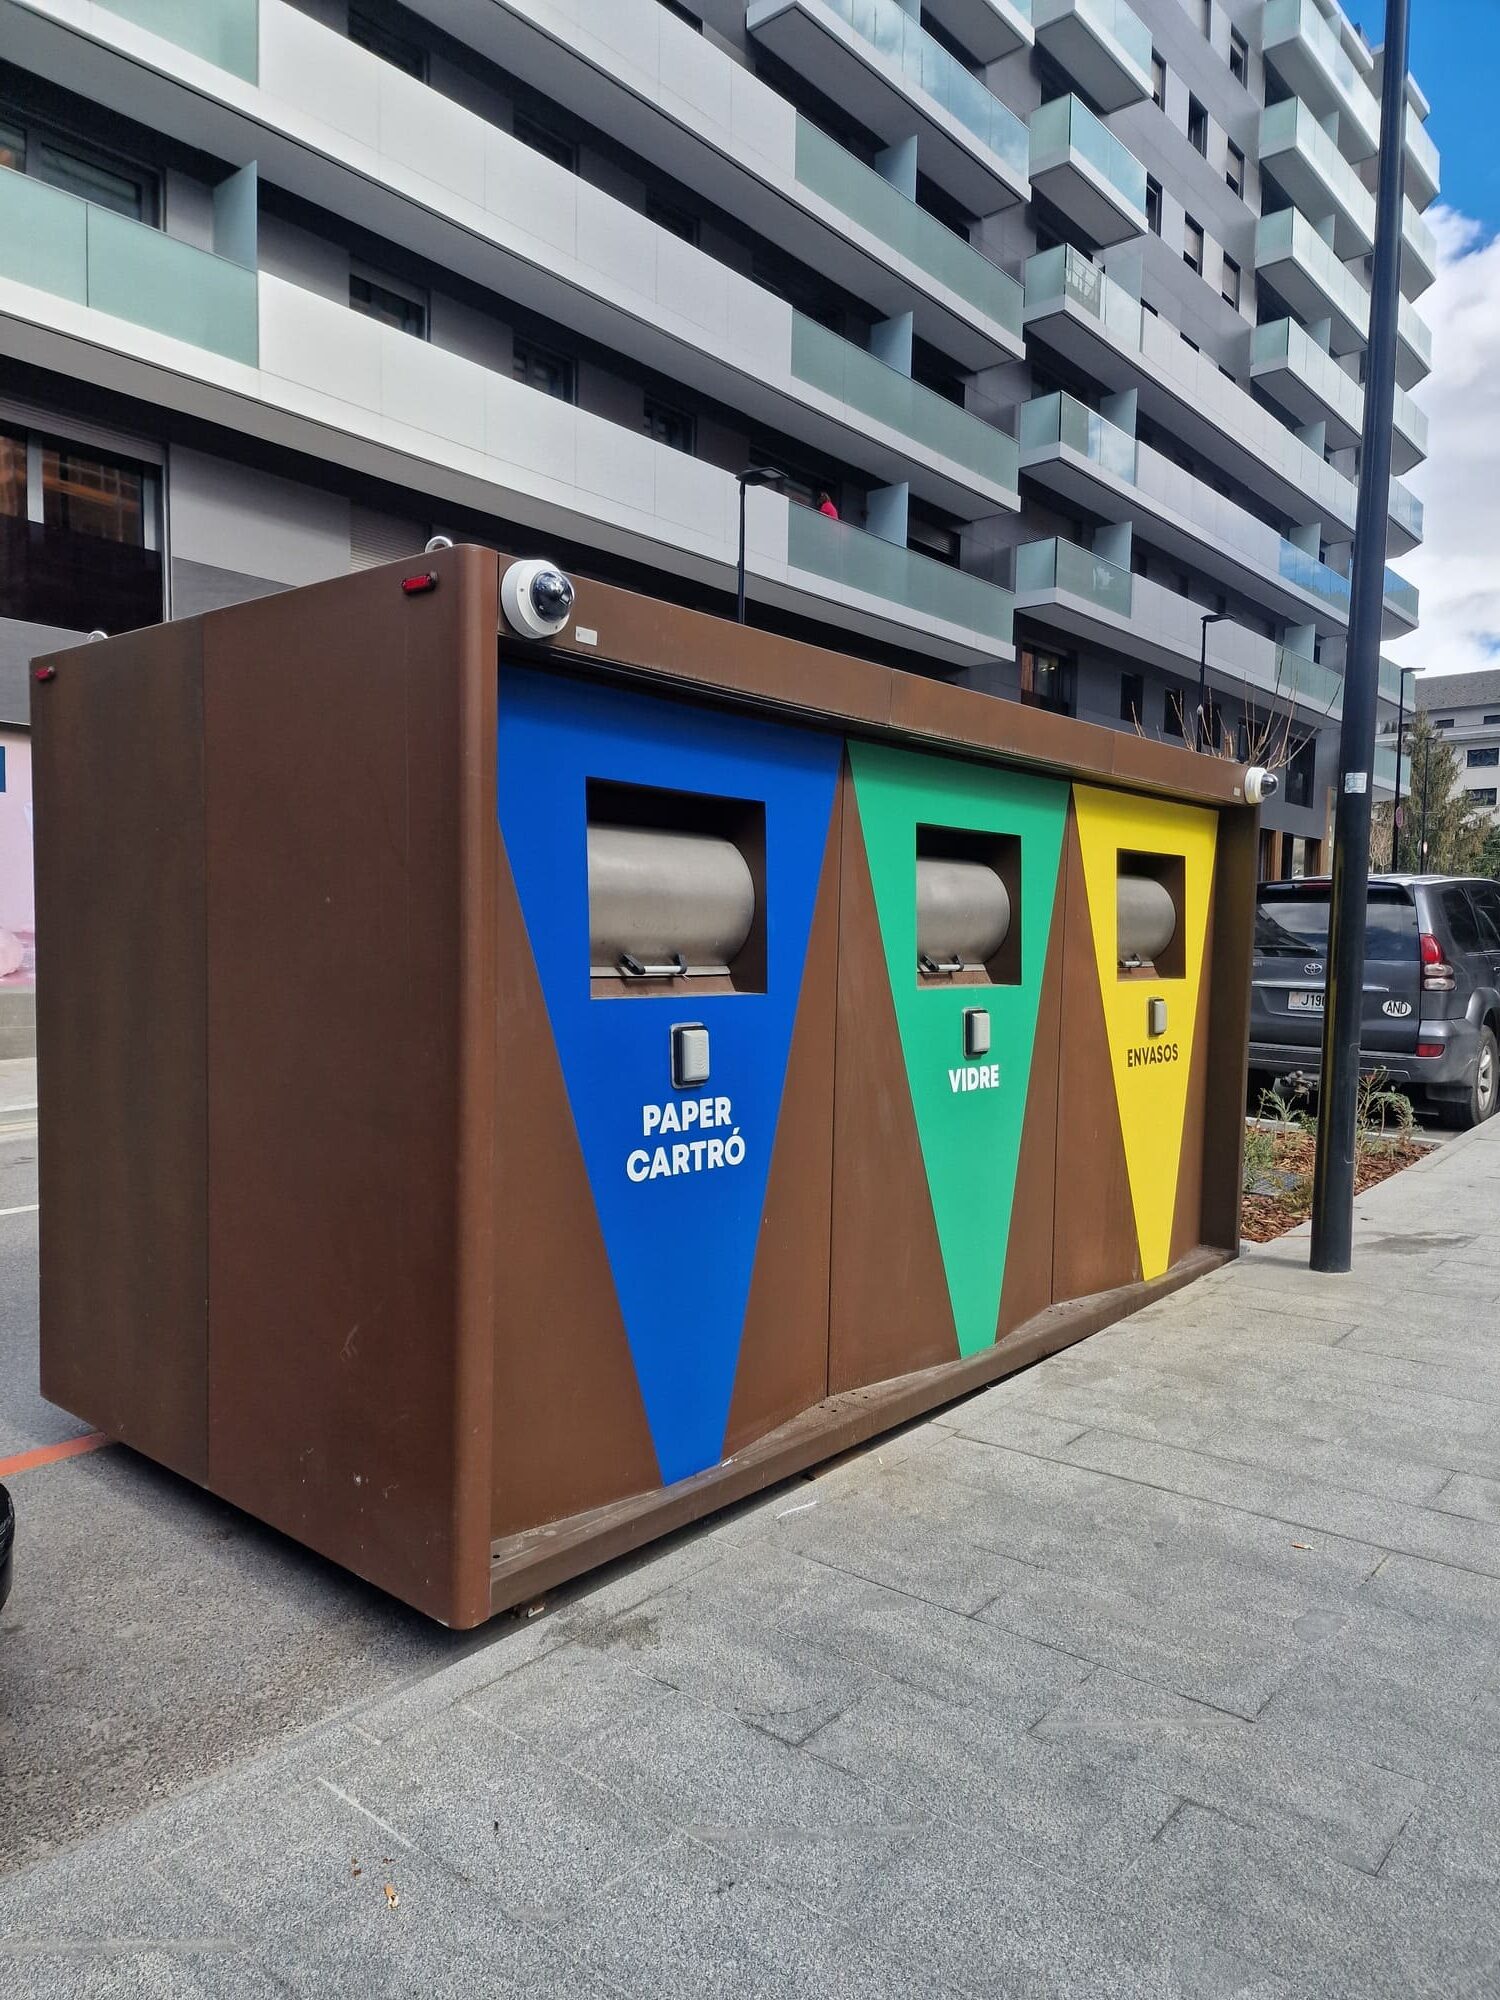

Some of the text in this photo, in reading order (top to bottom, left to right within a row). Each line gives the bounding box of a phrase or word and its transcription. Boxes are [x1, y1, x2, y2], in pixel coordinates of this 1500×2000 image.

[1386, 1001, 1408, 1015] AND
[1127, 1043, 1179, 1068] ENVASOS
[948, 1064, 1000, 1094] VIDRE
[642, 1096, 732, 1136] PAPER
[626, 1127, 746, 1182] CARTRÓ
